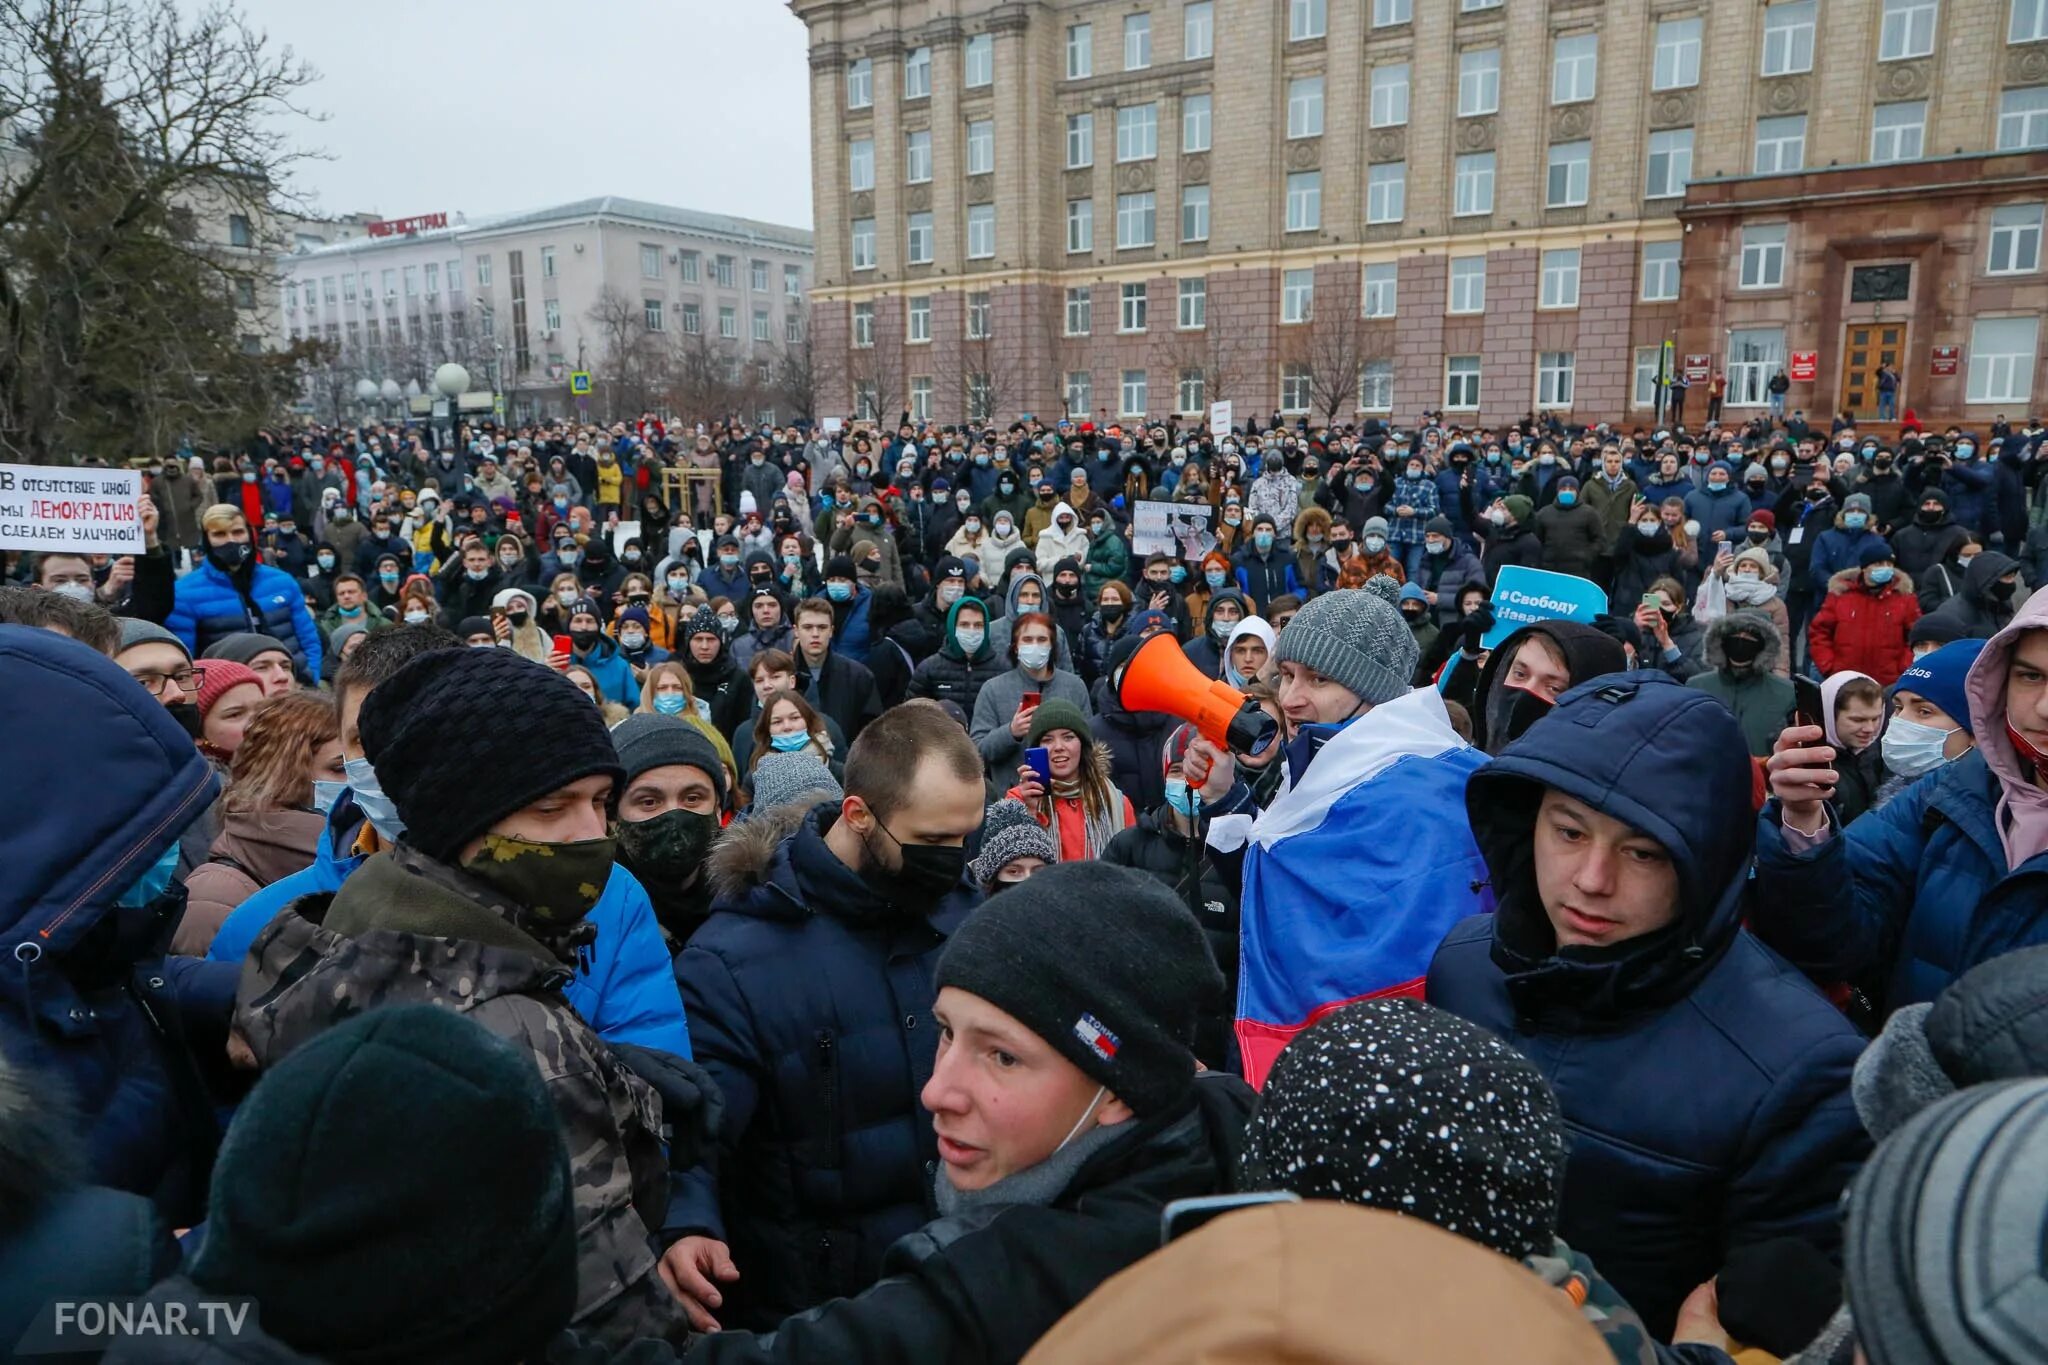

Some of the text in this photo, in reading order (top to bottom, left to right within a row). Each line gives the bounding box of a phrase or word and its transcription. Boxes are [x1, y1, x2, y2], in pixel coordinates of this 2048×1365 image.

[0, 471, 15, 491] В
[31, 500, 135, 521] ДЕМОКРАТИЮ
[1500, 590, 1578, 616] #Свободу
[1088, 1015, 1119, 1042] TOMMY
